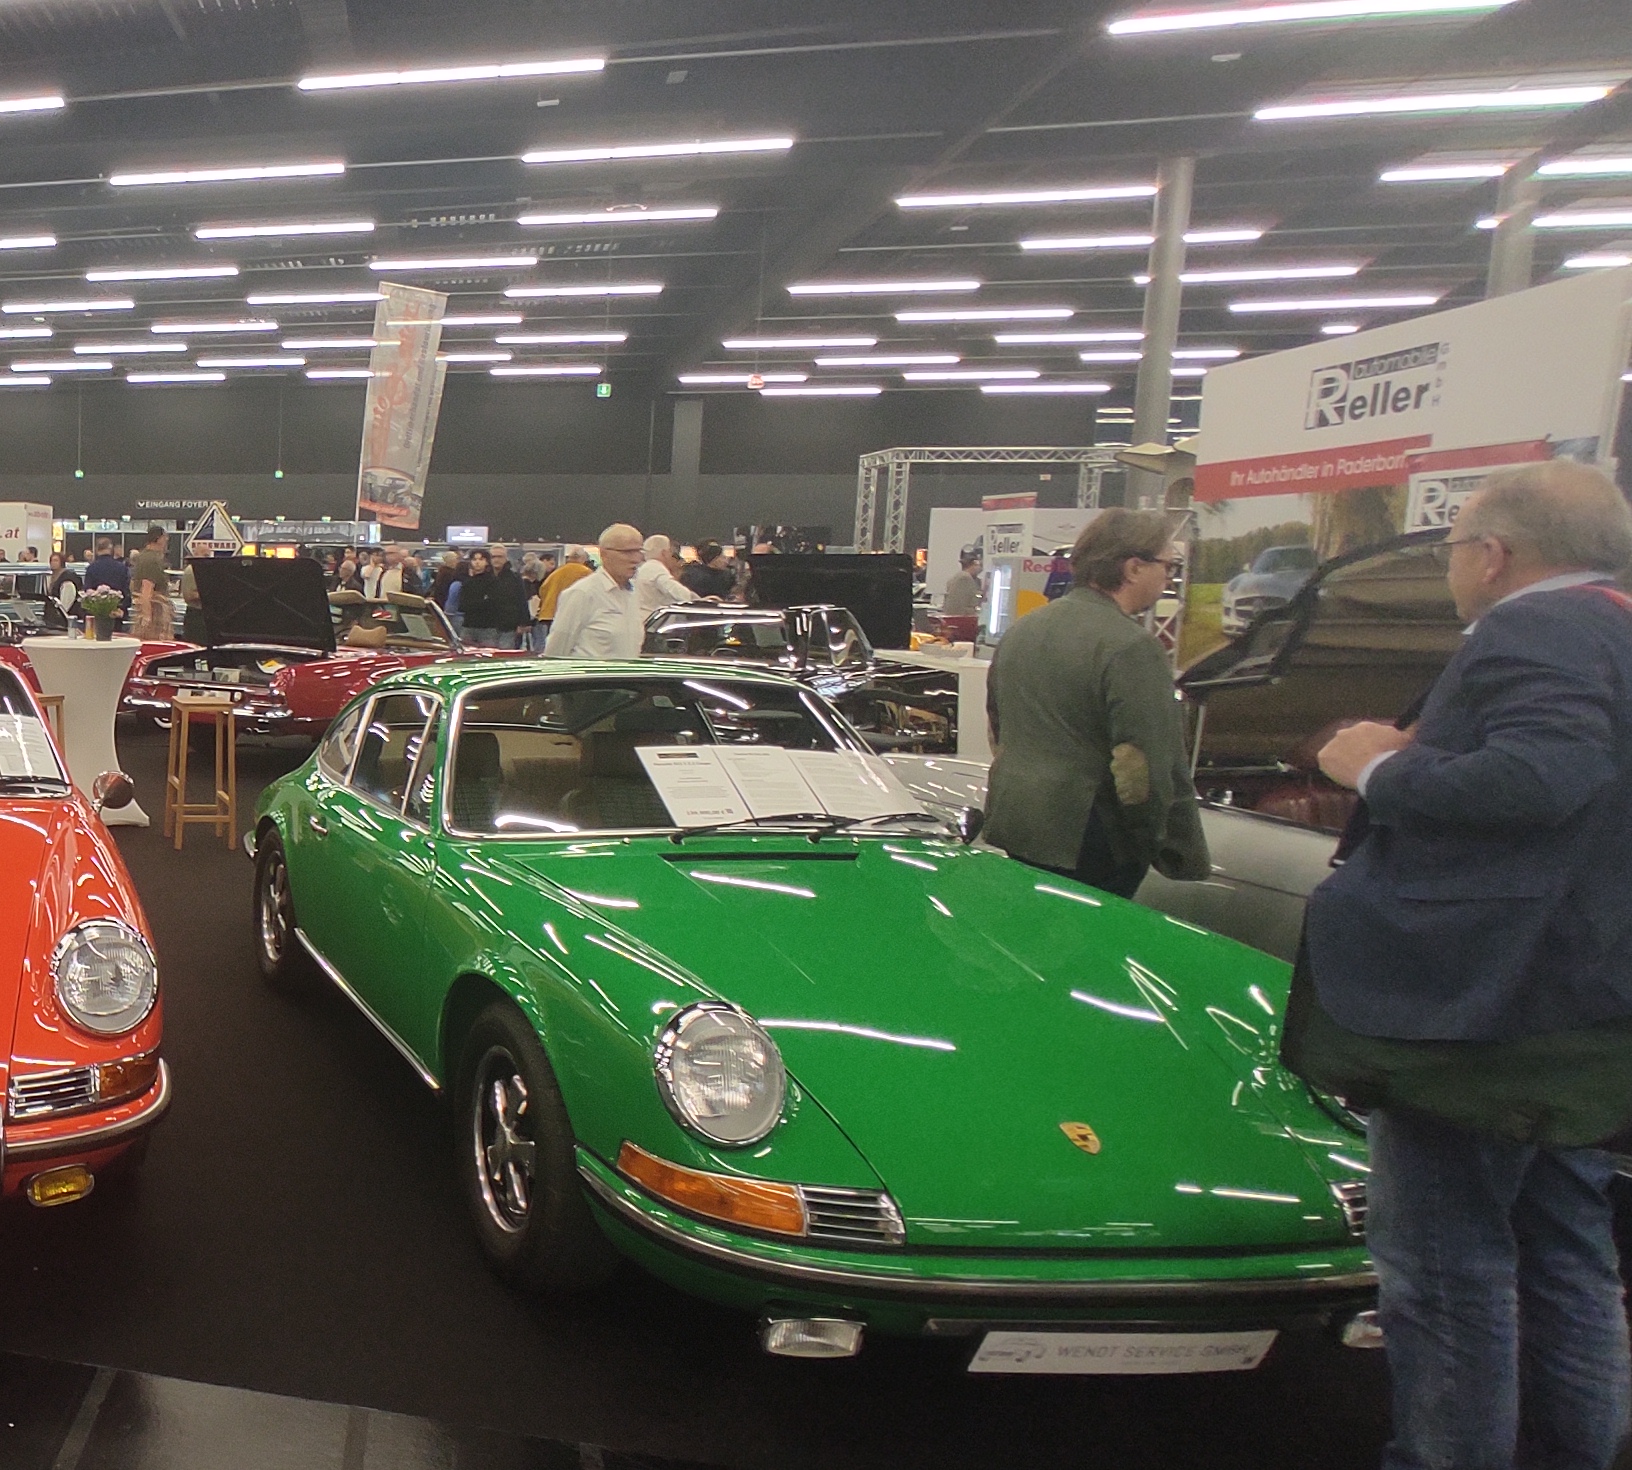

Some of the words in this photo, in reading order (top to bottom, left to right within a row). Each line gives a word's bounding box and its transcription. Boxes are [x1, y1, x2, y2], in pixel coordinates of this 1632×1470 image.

[1304, 361, 1430, 429] Reller
[145, 500, 181, 509] EINGANG
[191, 541, 236, 549] BGWARD
[1057, 1345, 1119, 1358] WENDT
[1123, 1345, 1197, 1358] SERVICE
